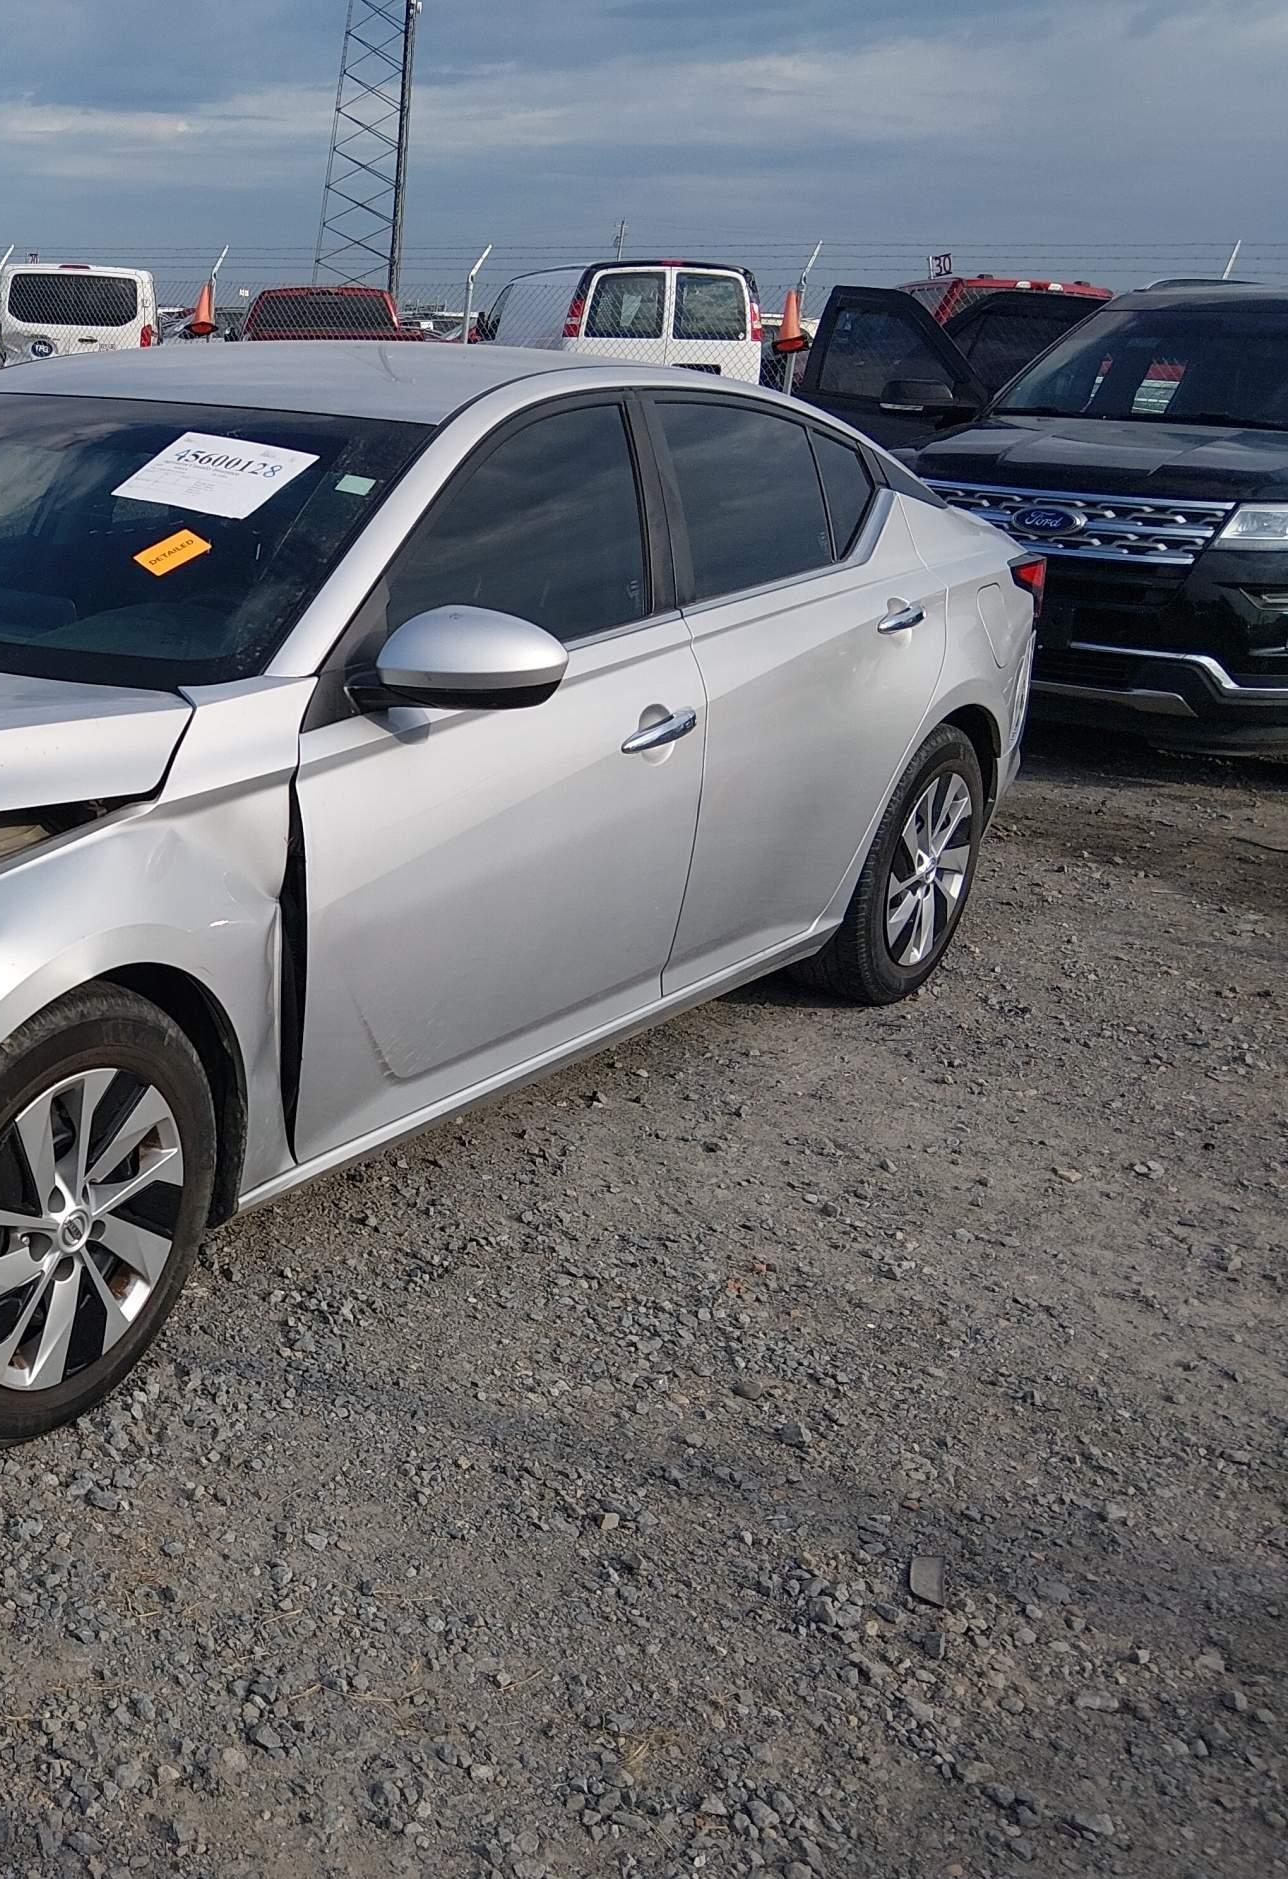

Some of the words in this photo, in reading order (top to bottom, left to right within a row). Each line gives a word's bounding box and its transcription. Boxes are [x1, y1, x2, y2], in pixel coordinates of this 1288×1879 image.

[934, 255, 952, 275] 30
[174, 448, 284, 479] 45600128
[1024, 510, 1064, 528] Ford
[148, 539, 194, 566] DETAILED
